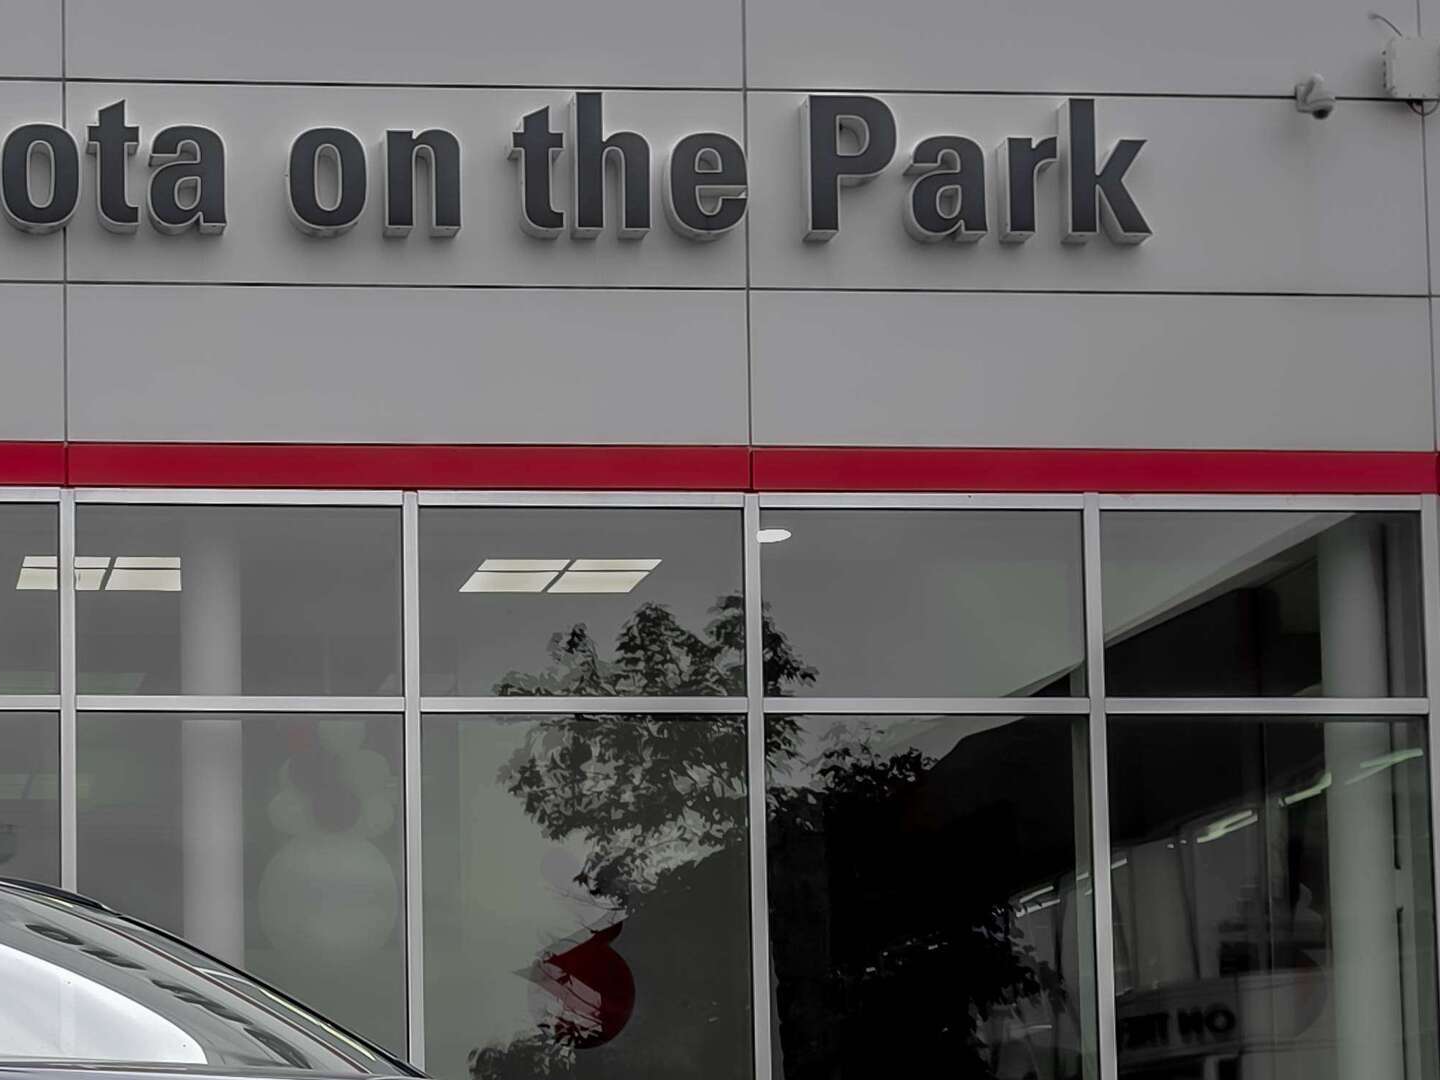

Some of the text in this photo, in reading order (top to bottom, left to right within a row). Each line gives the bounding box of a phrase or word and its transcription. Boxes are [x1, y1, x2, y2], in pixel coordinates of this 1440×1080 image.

[286, 126, 462, 238] on
[506, 90, 748, 242] the
[802, 94, 1153, 246] Park
